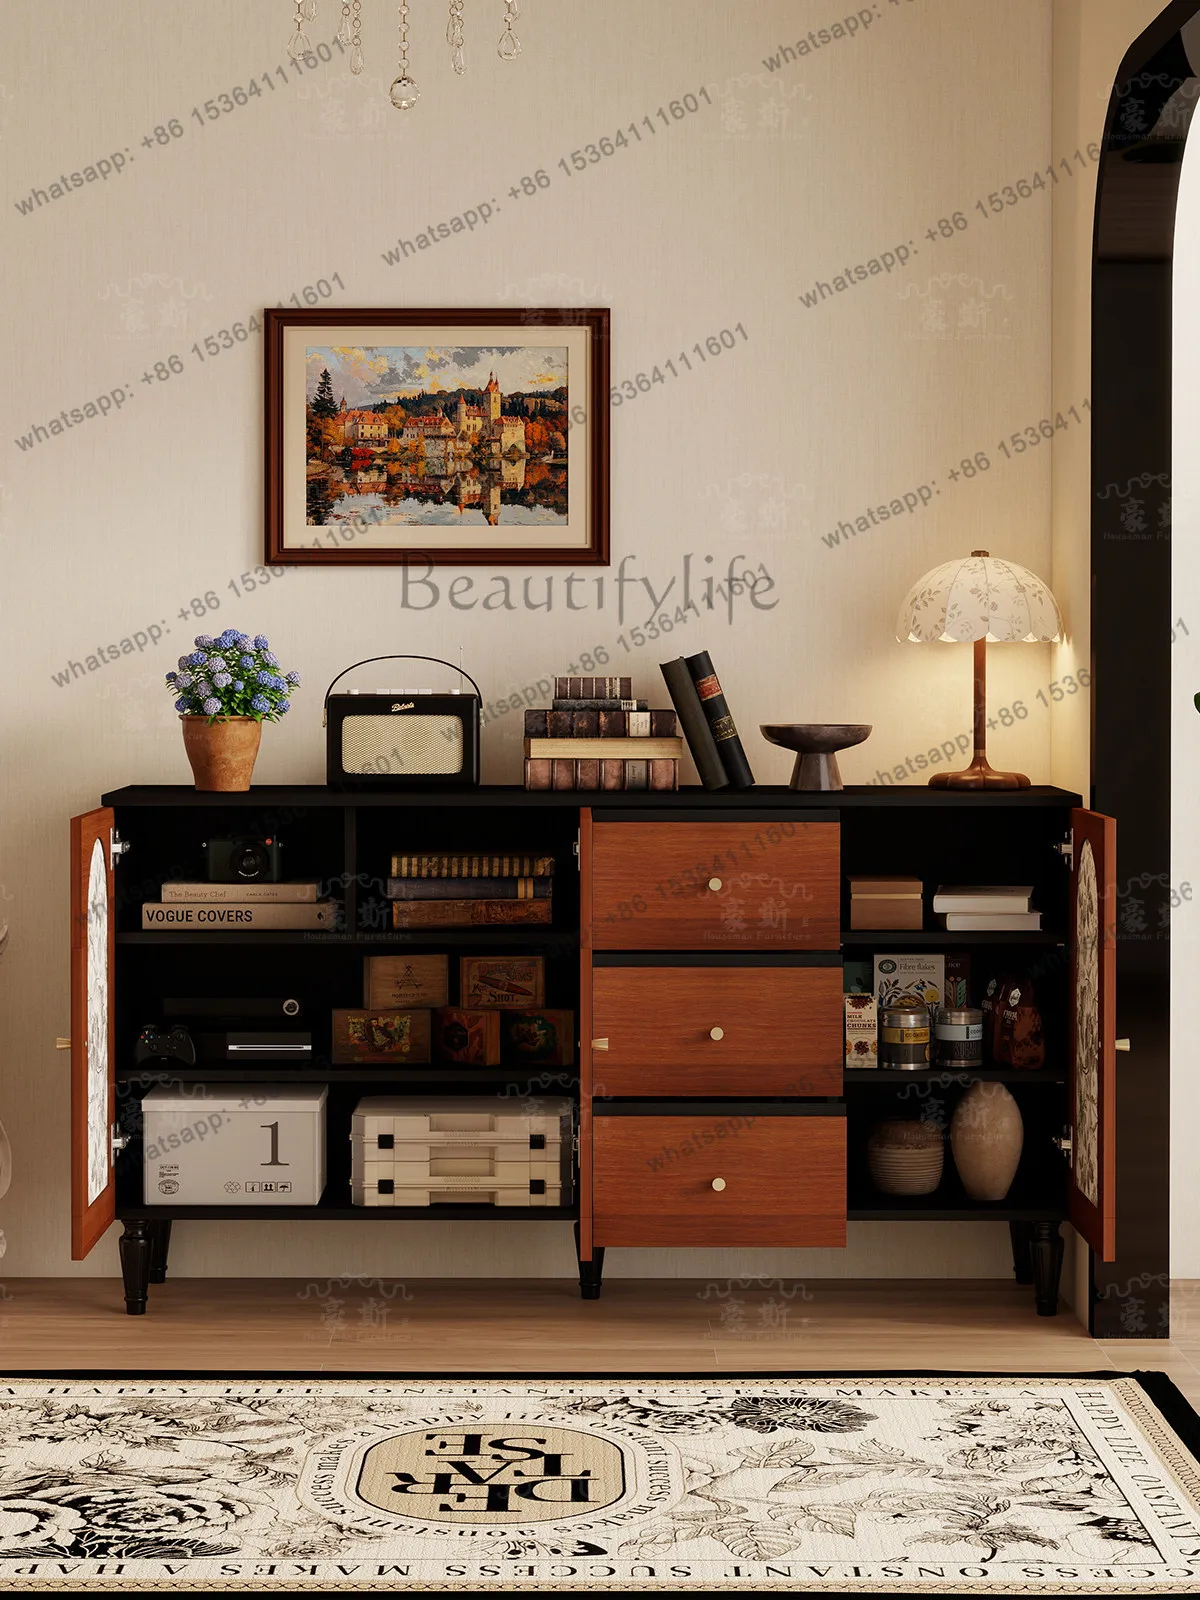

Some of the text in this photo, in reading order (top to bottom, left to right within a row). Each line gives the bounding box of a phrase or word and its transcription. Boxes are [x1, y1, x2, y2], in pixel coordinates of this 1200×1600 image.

[184, 891, 207, 900] Beauty
[146, 910, 253, 922] VOGUE COVERS
[900, 963, 916, 971] Fibre
[917, 963, 935, 971] flakes
[260, 1121, 289, 1166] 1
[0, 1563, 126, 1576] HAP
[160, 1563, 190, 1576] A
[220, 1563, 411, 1577] MAKES
[445, 1564, 694, 1578] SUCCESS
[724, 1564, 990, 1578] ONSTANT
